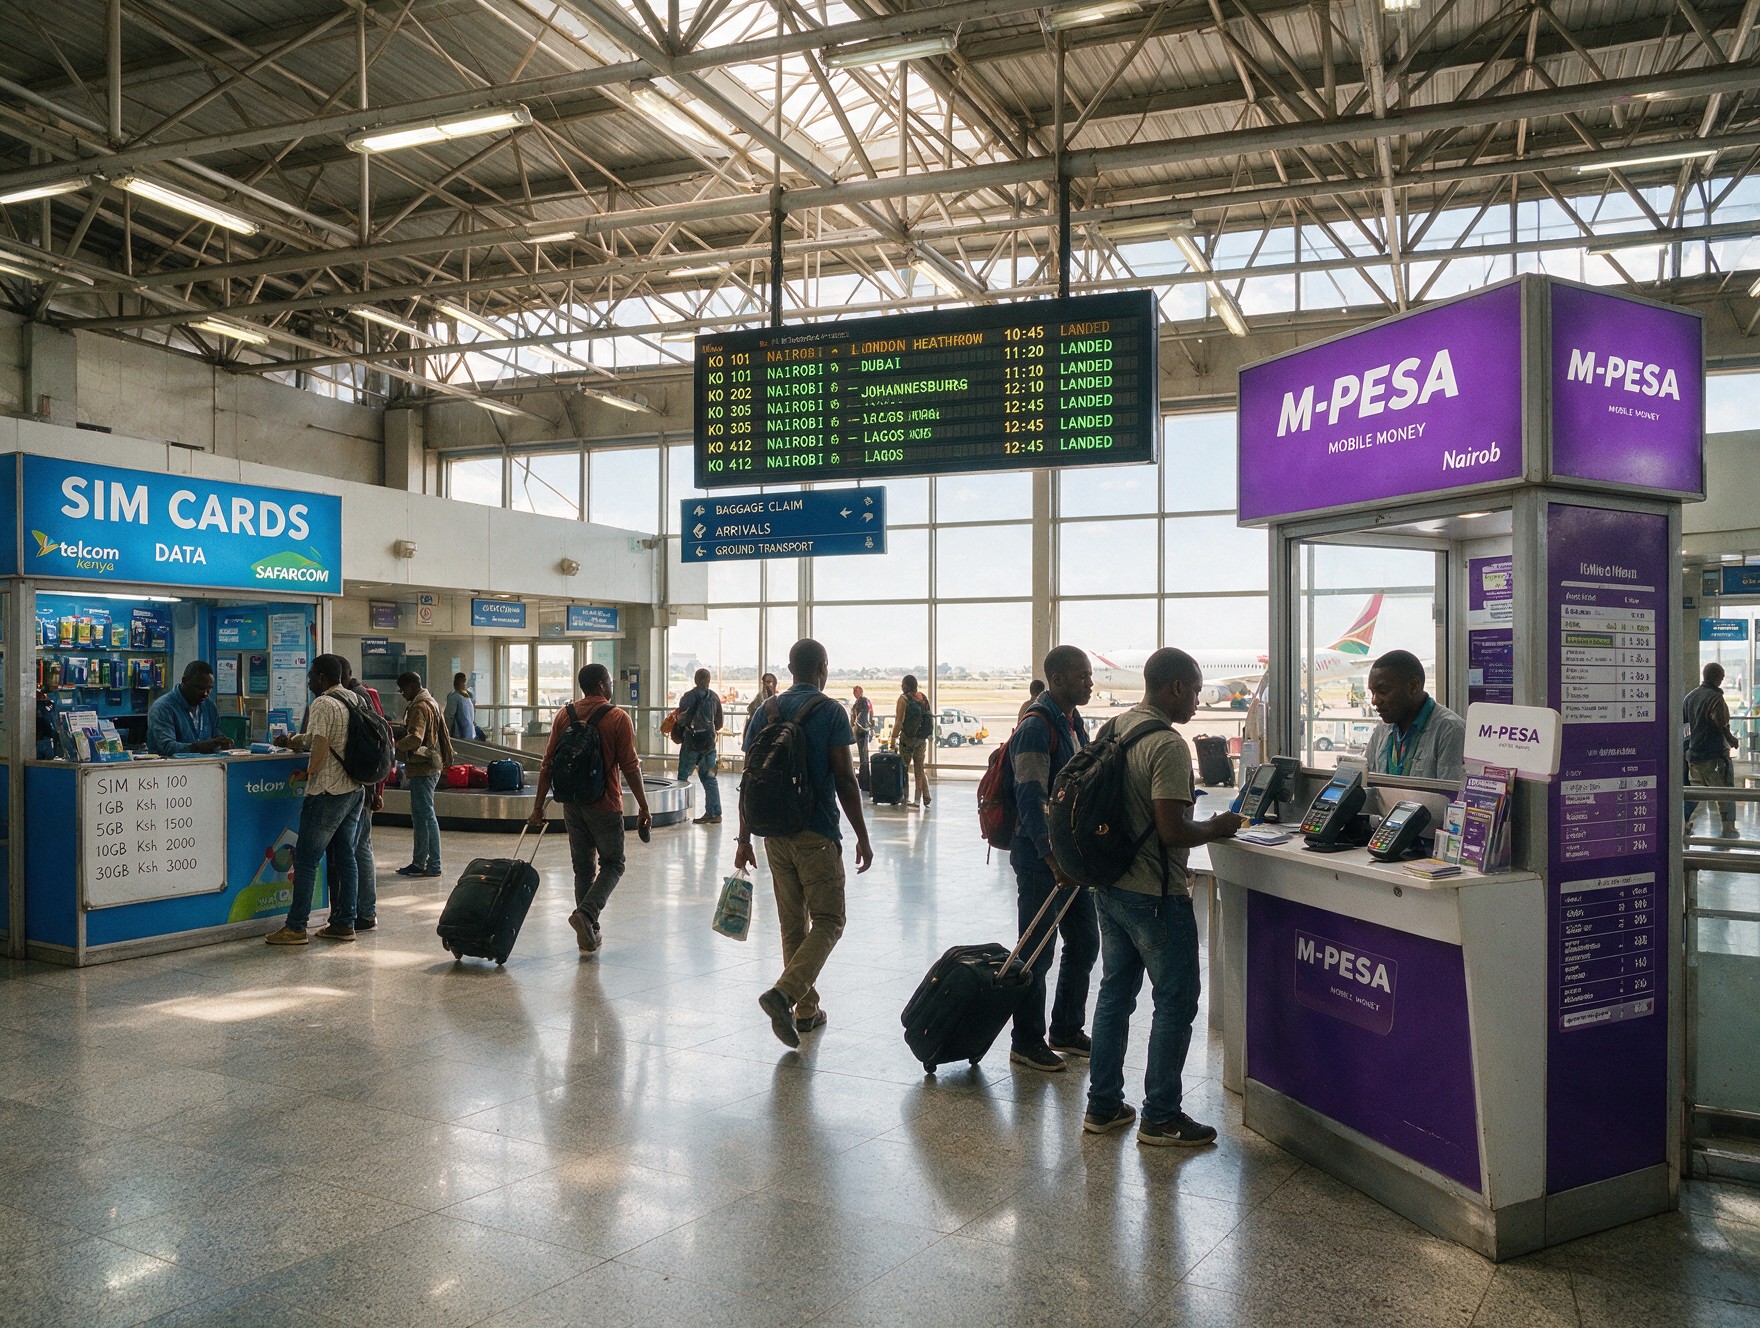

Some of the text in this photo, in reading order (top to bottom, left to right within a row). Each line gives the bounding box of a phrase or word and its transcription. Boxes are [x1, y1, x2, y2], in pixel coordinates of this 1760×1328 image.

[708, 355, 724, 367] KO
[730, 353, 750, 366] 101
[913, 332, 983, 350] HEATHROW
[1004, 326, 1044, 341] 10:45
[1060, 320, 1110, 336] LANDED
[708, 339, 1112, 384] KO 101 NAIROBI DUBAI 11:20 LANDED
[1567, 348, 1680, 401] M-PESA
[708, 389, 724, 402] KO
[730, 387, 752, 400] 202
[767, 382, 824, 398] NAIROBI
[1060, 358, 1112, 375] LANDED
[1276, 348, 1459, 437] M-PESA
[708, 376, 1112, 418] KO 305 NAIROBI 12:10 LANDED
[708, 424, 724, 436] KO
[730, 422, 751, 434] 305
[767, 416, 824, 432] NAIROBI
[1004, 398, 1044, 413] 12:45
[1060, 394, 1112, 410] LANDED
[708, 441, 724, 454] KO
[729, 440, 752, 452] 412
[767, 434, 824, 450] NAIROBI
[864, 429, 904, 442] LAGOS
[1004, 418, 1044, 433] 12:45
[1060, 414, 1112, 430] LANDED
[1328, 422, 1426, 454] MOBILE MONEY
[708, 435, 1112, 472] KO 412 NAIROBI LAGOS 12:45 LANDED
[1442, 441, 1501, 471] Nairob
[60, 476, 310, 541] SIM CARDS
[716, 499, 803, 516] BAGGAGE CLAIM
[715, 522, 771, 537] ARRIVALS
[60, 540, 119, 560] telcom
[155, 543, 207, 565] DATA
[715, 542, 814, 556] GROUND TRANSPORT
[255, 565, 330, 583] SAFARCOM
[1478, 724, 1540, 744] M-PESA
[97, 774, 188, 795] SIM Ksh 100
[96, 796, 192, 815] 1GB Ksh 1000
[96, 816, 193, 837] 5GB Ksh 1500
[96, 836, 196, 858] 10GB Ksh 2000
[96, 858, 198, 880] 30GB Ksh 3000
[1297, 936, 1391, 994] M-PESA
